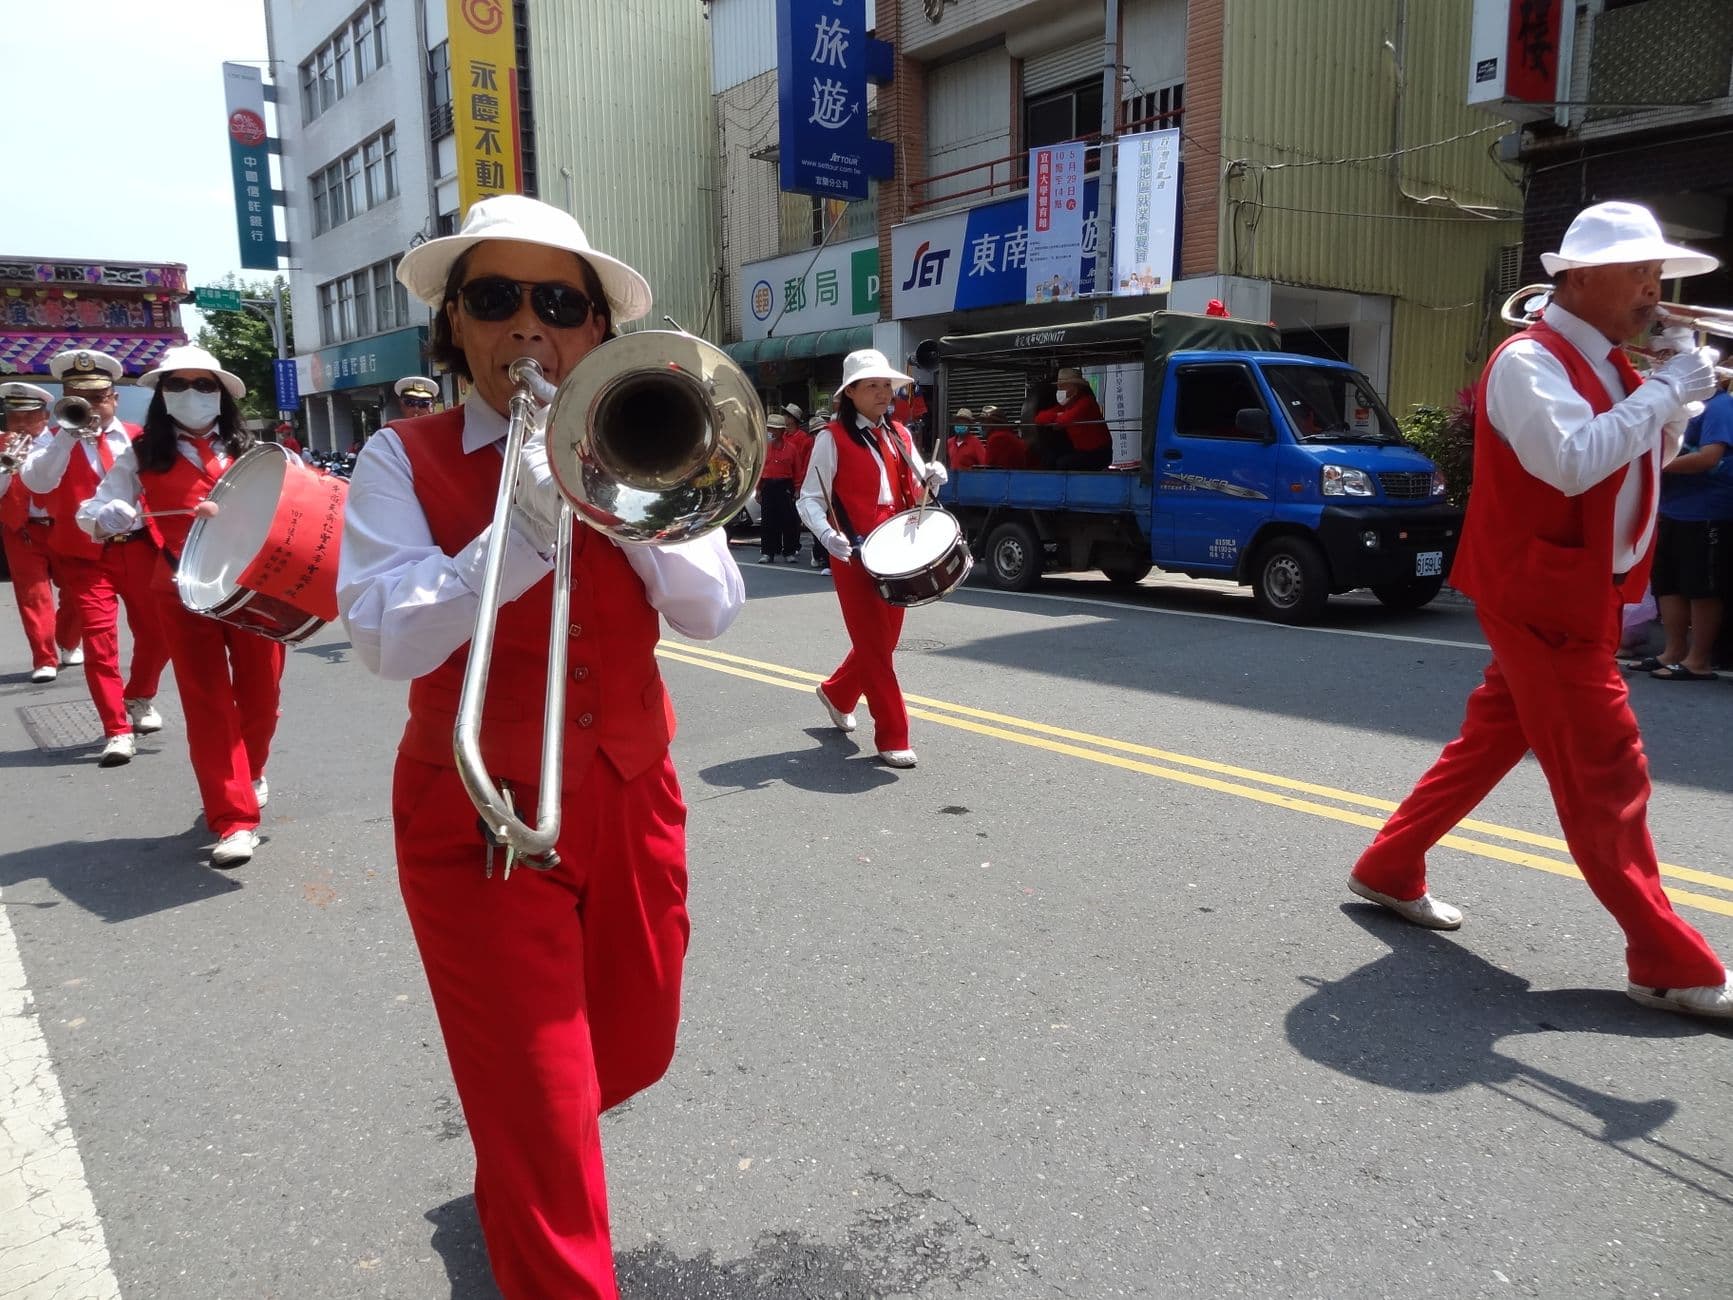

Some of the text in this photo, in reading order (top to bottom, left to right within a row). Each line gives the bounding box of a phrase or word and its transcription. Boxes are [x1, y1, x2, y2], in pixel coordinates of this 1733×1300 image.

[809, 0, 853, 129] 旅遊
[244, 156, 264, 242] 中國信託銀行
[784, 269, 839, 314] 郵局
[325, 354, 377, 378] 中國信託銀行
